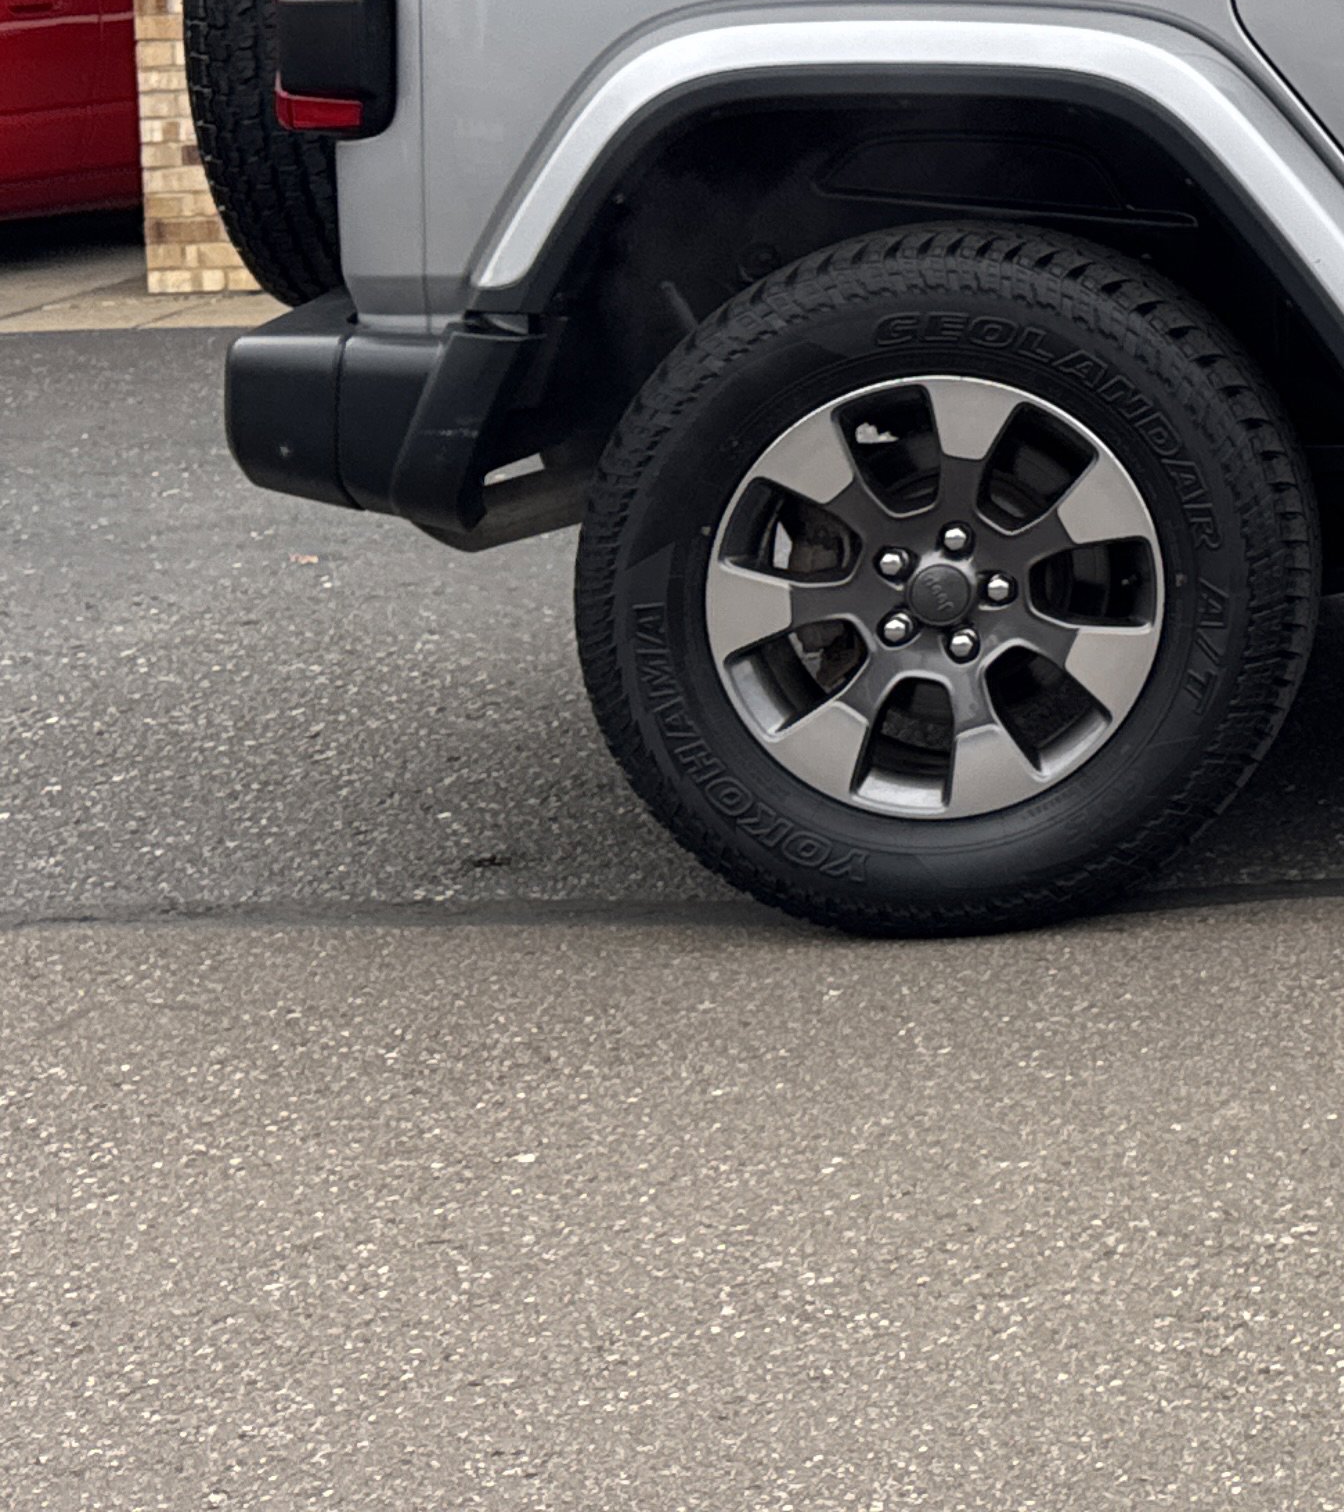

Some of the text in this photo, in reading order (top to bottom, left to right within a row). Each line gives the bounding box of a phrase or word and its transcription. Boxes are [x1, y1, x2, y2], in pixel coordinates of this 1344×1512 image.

[873, 309, 1224, 553] GEOLANDAR
[1177, 582, 1231, 718] A/T
[630, 598, 870, 885] YOKOHAMA
